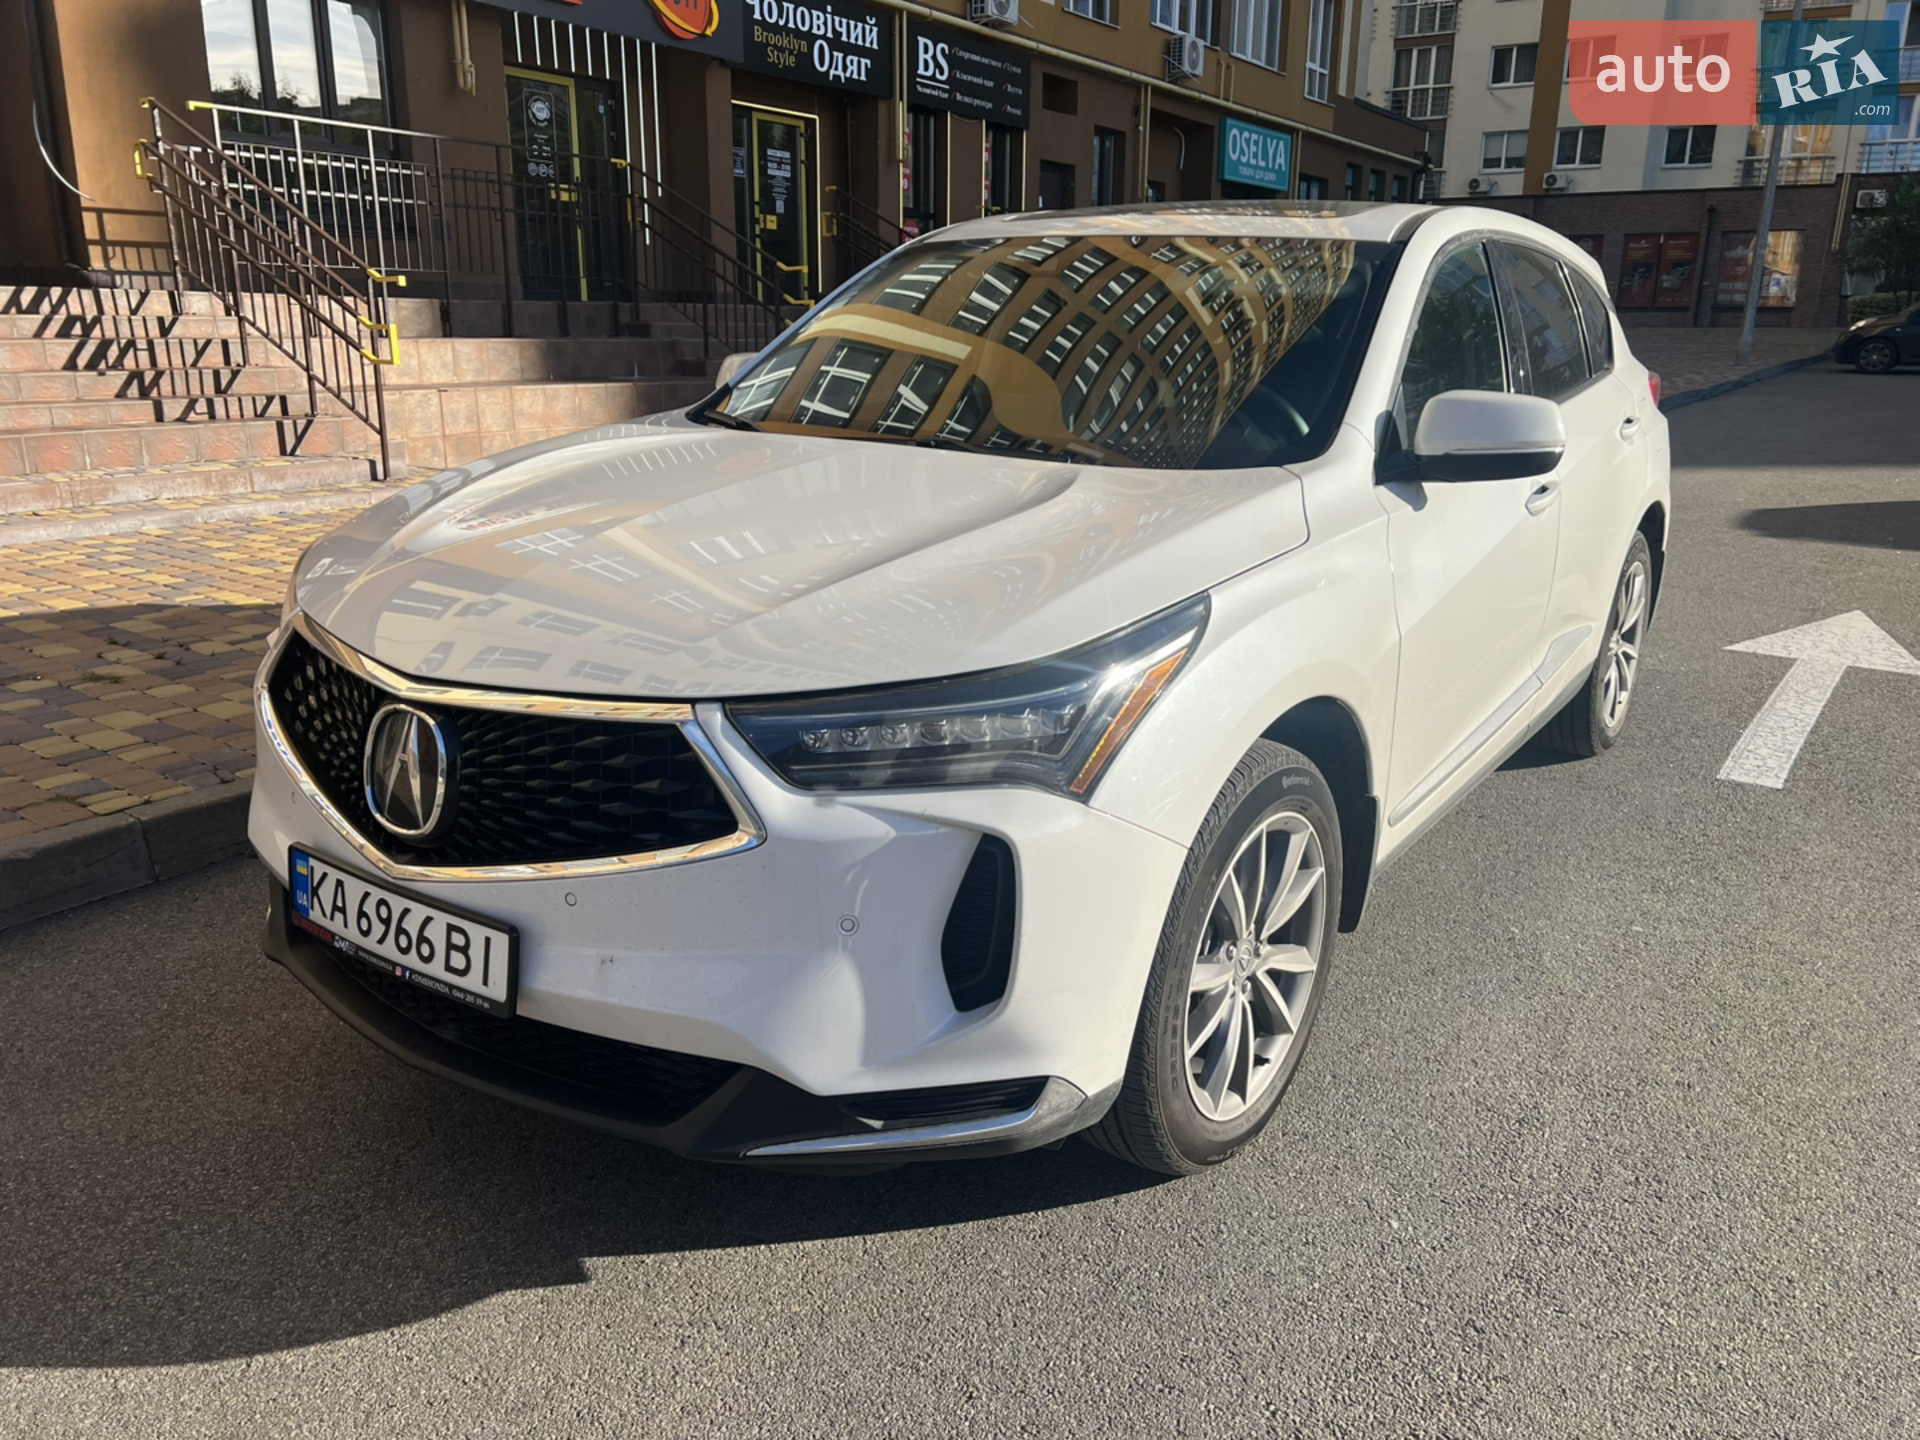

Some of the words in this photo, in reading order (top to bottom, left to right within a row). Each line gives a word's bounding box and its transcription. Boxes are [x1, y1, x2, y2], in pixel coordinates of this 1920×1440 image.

[753, 25, 808, 54] Brooklyn
[767, 46, 796, 68] Style
[813, 39, 871, 83] Одяг
[916, 35, 949, 81] BS
[1228, 127, 1286, 172] OSELYA
[296, 889, 309, 907] UA
[310, 864, 349, 930] KA
[356, 890, 436, 965] 6966
[444, 921, 492, 988] BI
